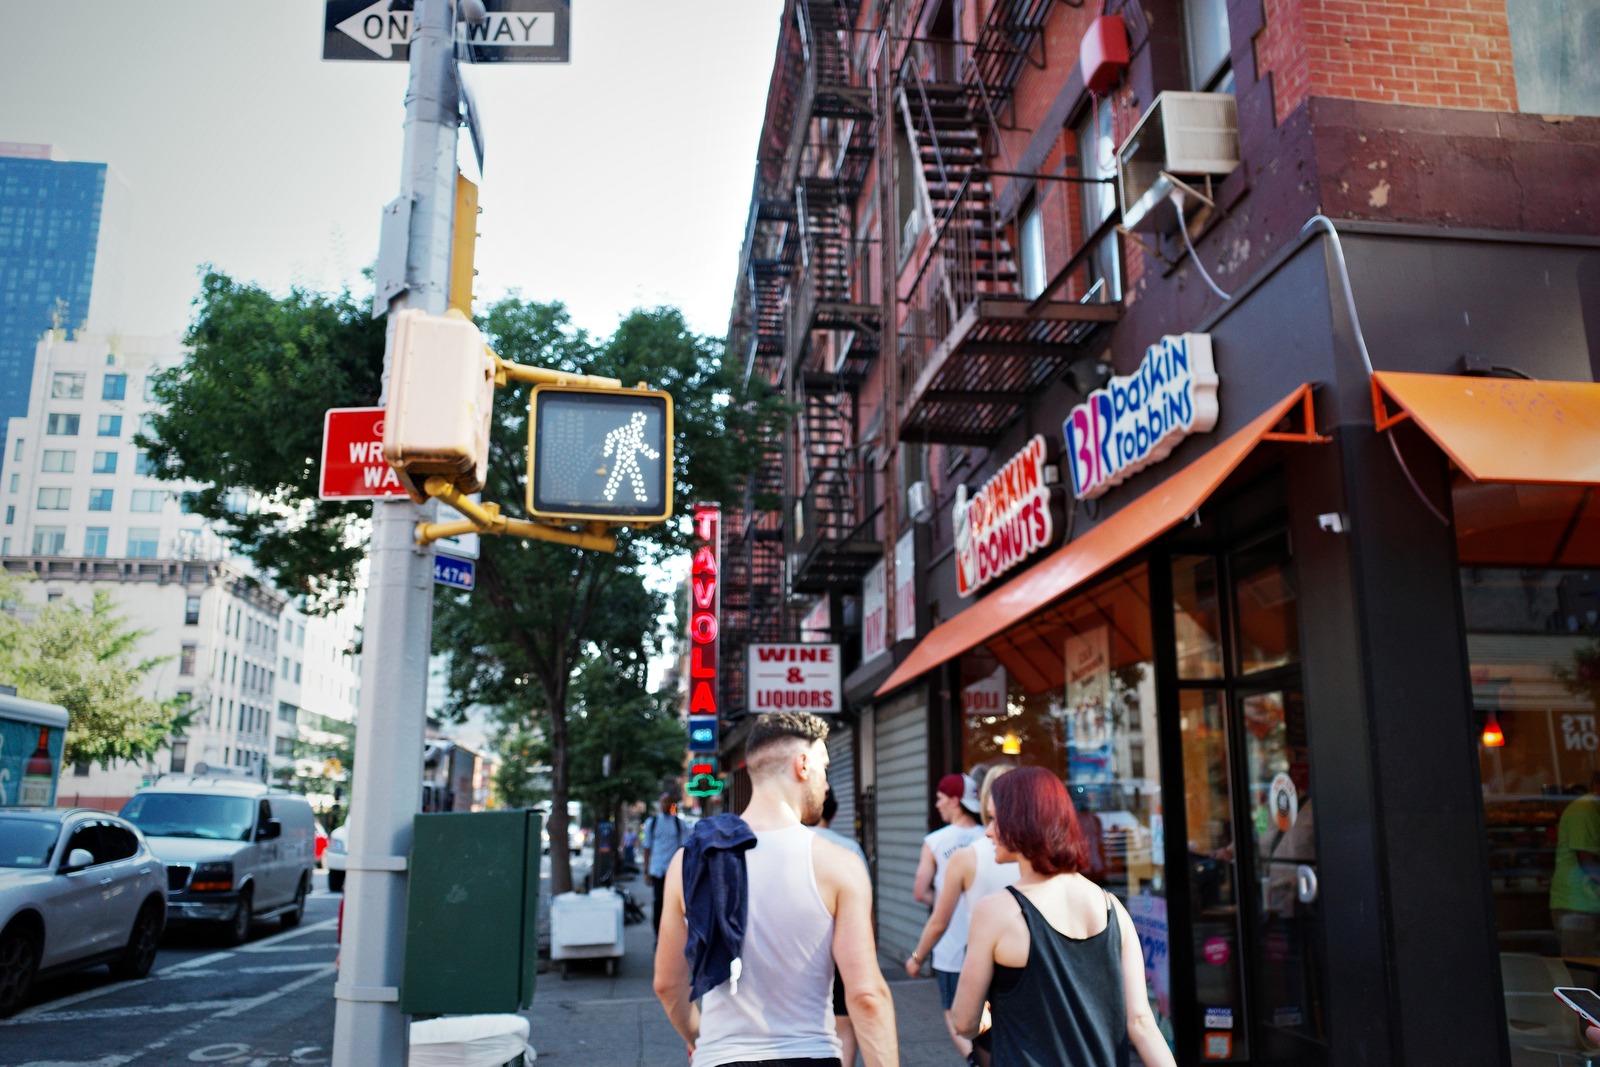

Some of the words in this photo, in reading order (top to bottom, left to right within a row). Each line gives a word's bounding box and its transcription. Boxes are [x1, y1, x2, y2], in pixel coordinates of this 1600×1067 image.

[363, 14, 408, 40] ON
[470, 16, 538, 42] WAY
[363, 466, 399, 488] WA
[978, 496, 1046, 581] DONUTS
[690, 510, 718, 713] TAVOLA
[758, 647, 833, 662] WINE
[786, 666, 804, 684] &
[757, 690, 833, 709] LIQUORS
